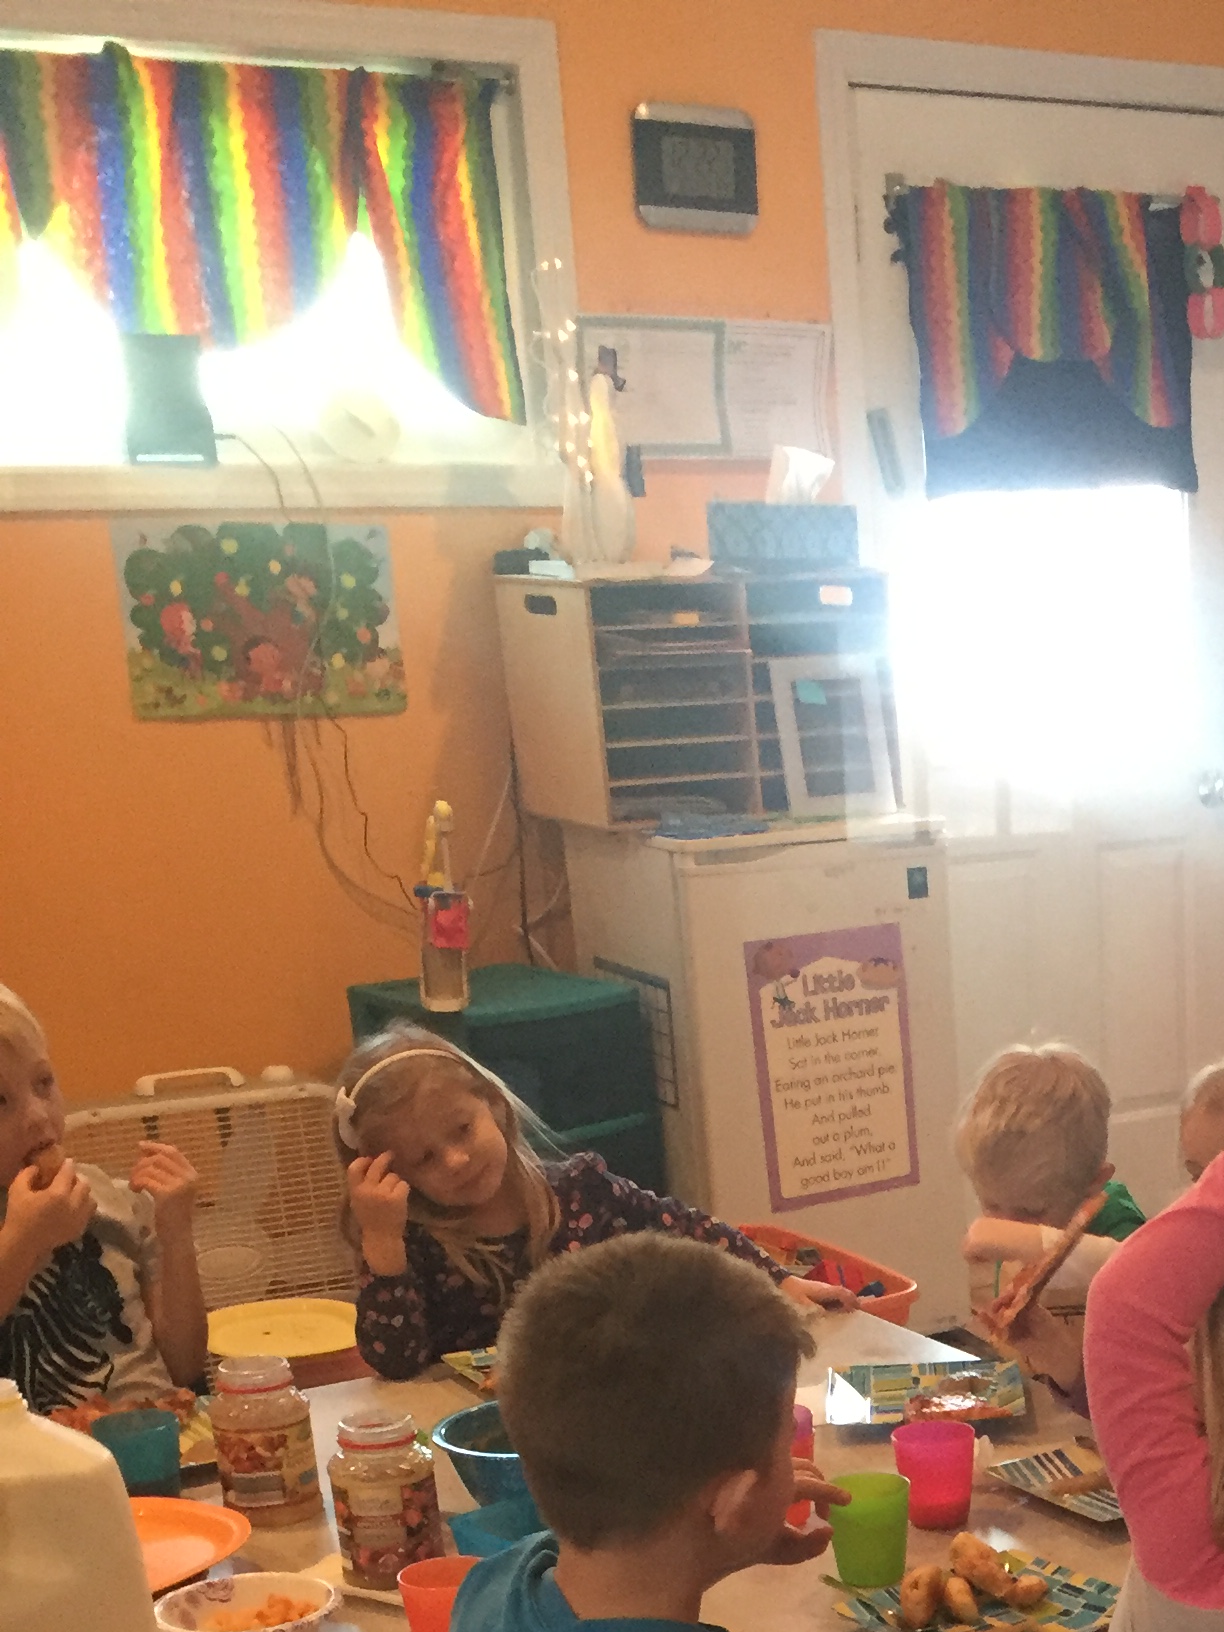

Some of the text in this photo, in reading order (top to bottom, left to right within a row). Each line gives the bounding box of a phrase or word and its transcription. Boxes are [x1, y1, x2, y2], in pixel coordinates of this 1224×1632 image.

[802, 970, 855, 997] Little
[770, 995, 890, 1028] Jack Horner
[786, 1035, 811, 1050] Little
[814, 1031, 838, 1047] Jack
[788, 1057, 808, 1070] Sat
[811, 1055, 822, 1066] in
[824, 1051, 841, 1063] the
[813, 1075, 829, 1086] an
[832, 1064, 874, 1084] orchard
[784, 1098, 801, 1110] He
[804, 1095, 822, 1111] put
[825, 1093, 836, 1103] in
[838, 1090, 853, 1101] his
[812, 1104, 872, 1125] And pulled
[812, 1133, 830, 1146] out
[793, 1152, 817, 1168] And
[800, 1171, 830, 1190] good
[833, 1168, 854, 1182] boy
[857, 1165, 874, 1176] am
